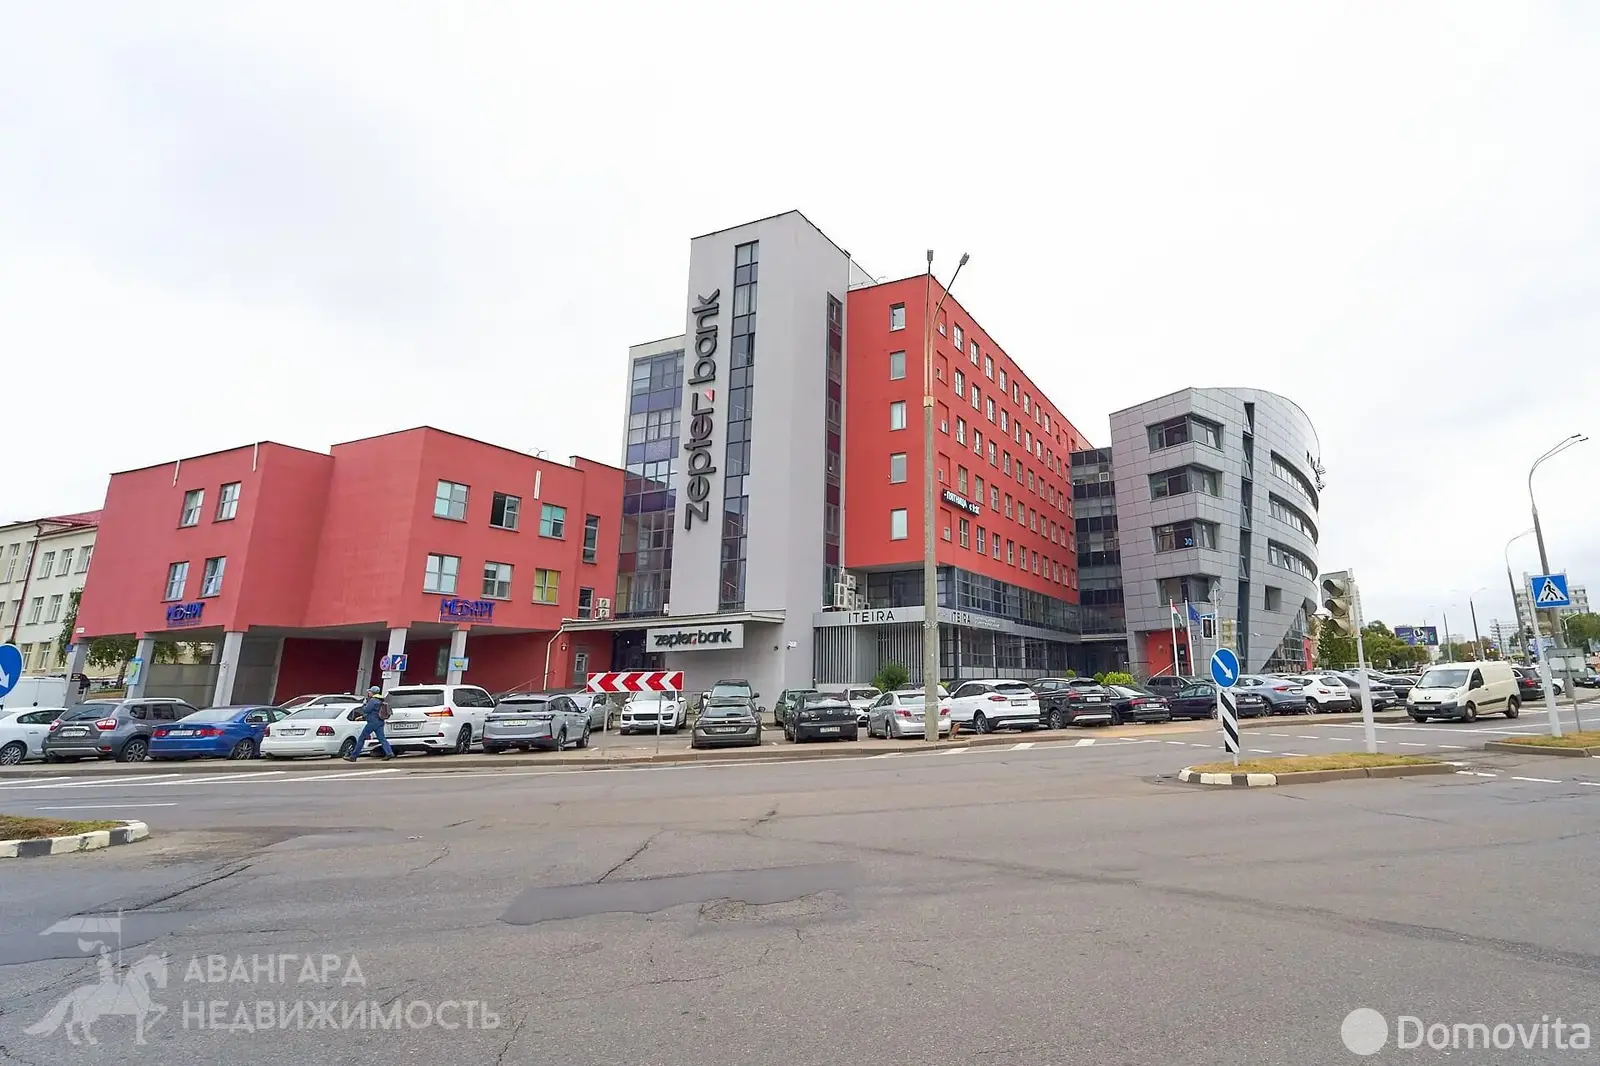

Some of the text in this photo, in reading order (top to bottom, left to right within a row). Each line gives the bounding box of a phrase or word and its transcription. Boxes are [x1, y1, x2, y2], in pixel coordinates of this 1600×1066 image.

[684, 288, 720, 532] zepter bank
[848, 610, 895, 624] ITEIRA
[653, 628, 732, 648] zepter bank
